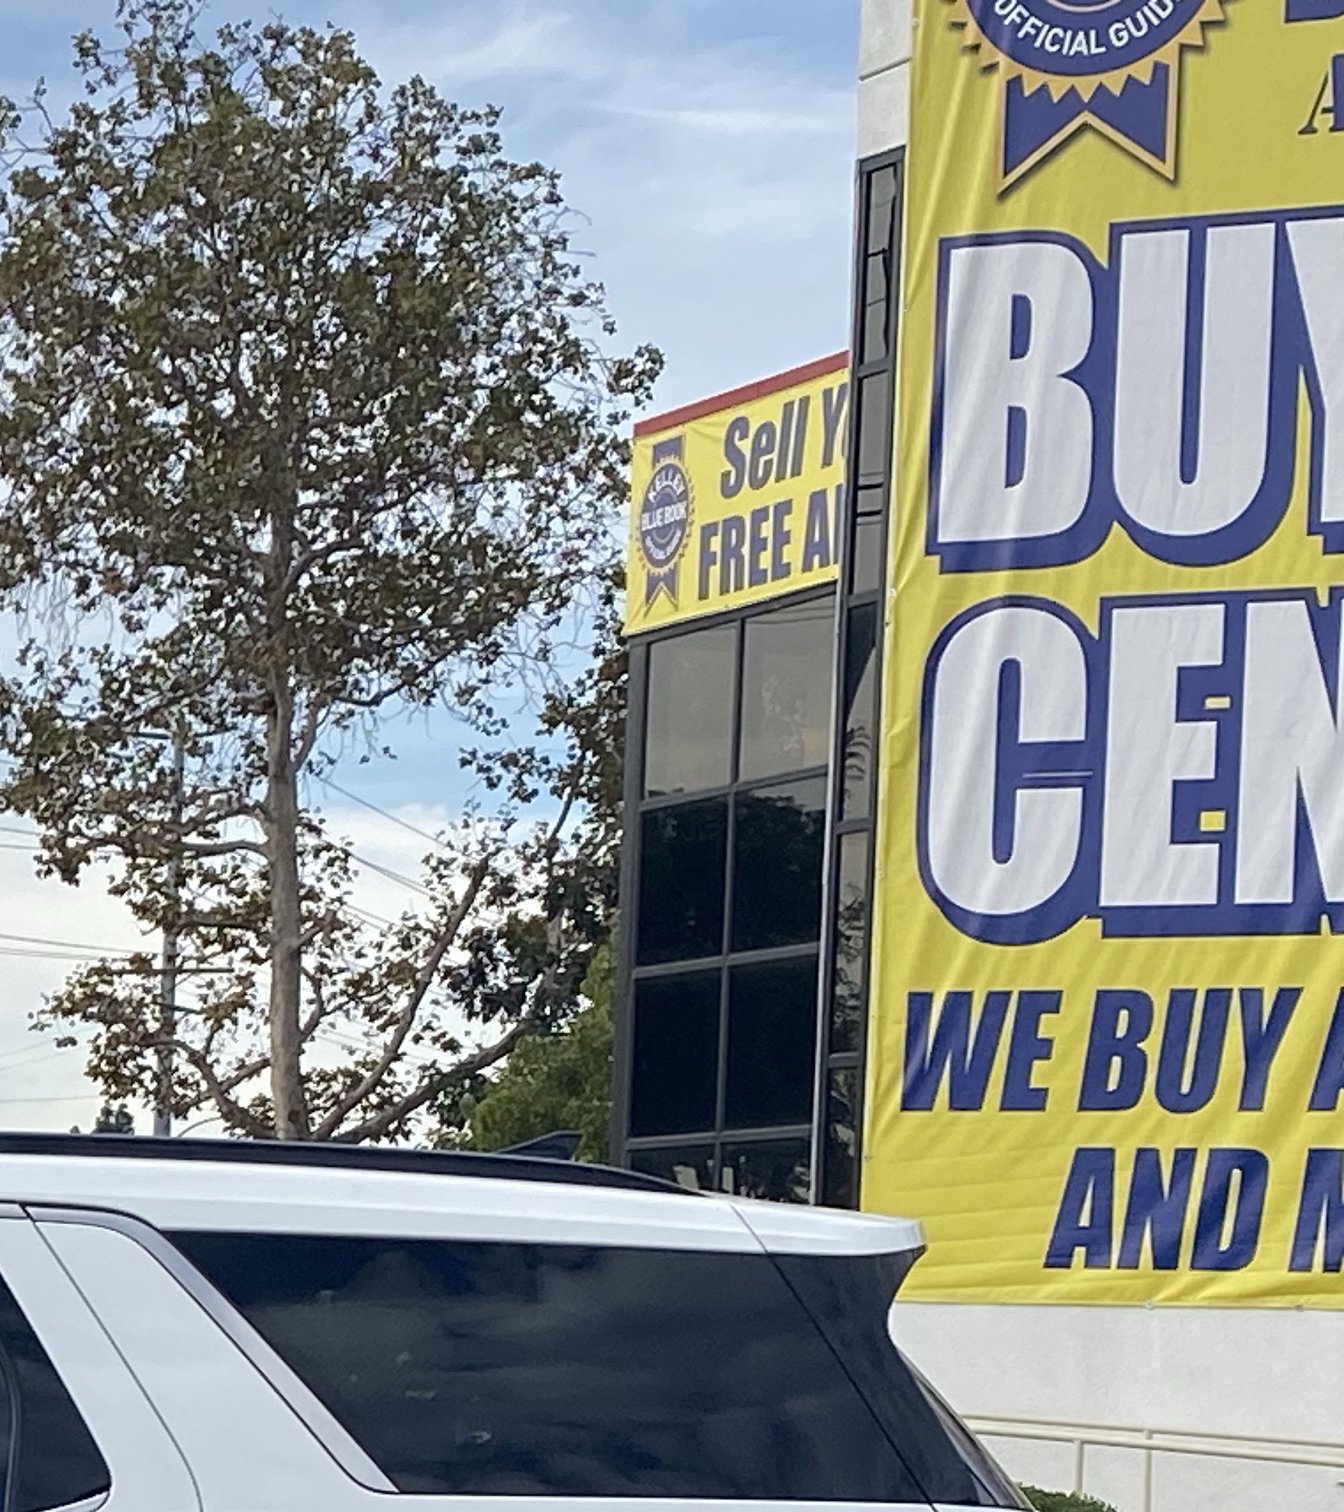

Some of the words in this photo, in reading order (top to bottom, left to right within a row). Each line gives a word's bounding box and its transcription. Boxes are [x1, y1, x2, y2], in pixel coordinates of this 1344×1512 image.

[1108, 0, 1183, 48] GUID
[647, 468, 685, 503] KELLEY
[720, 396, 811, 499] Sell
[821, 382, 849, 469] Y
[664, 500, 687, 526] BOOK
[698, 499, 794, 601] FREE
[920, 590, 1344, 940] CEN
[900, 988, 1064, 1113] WE
[1076, 986, 1305, 1114] BUY
[1042, 1146, 1270, 1272] AND
